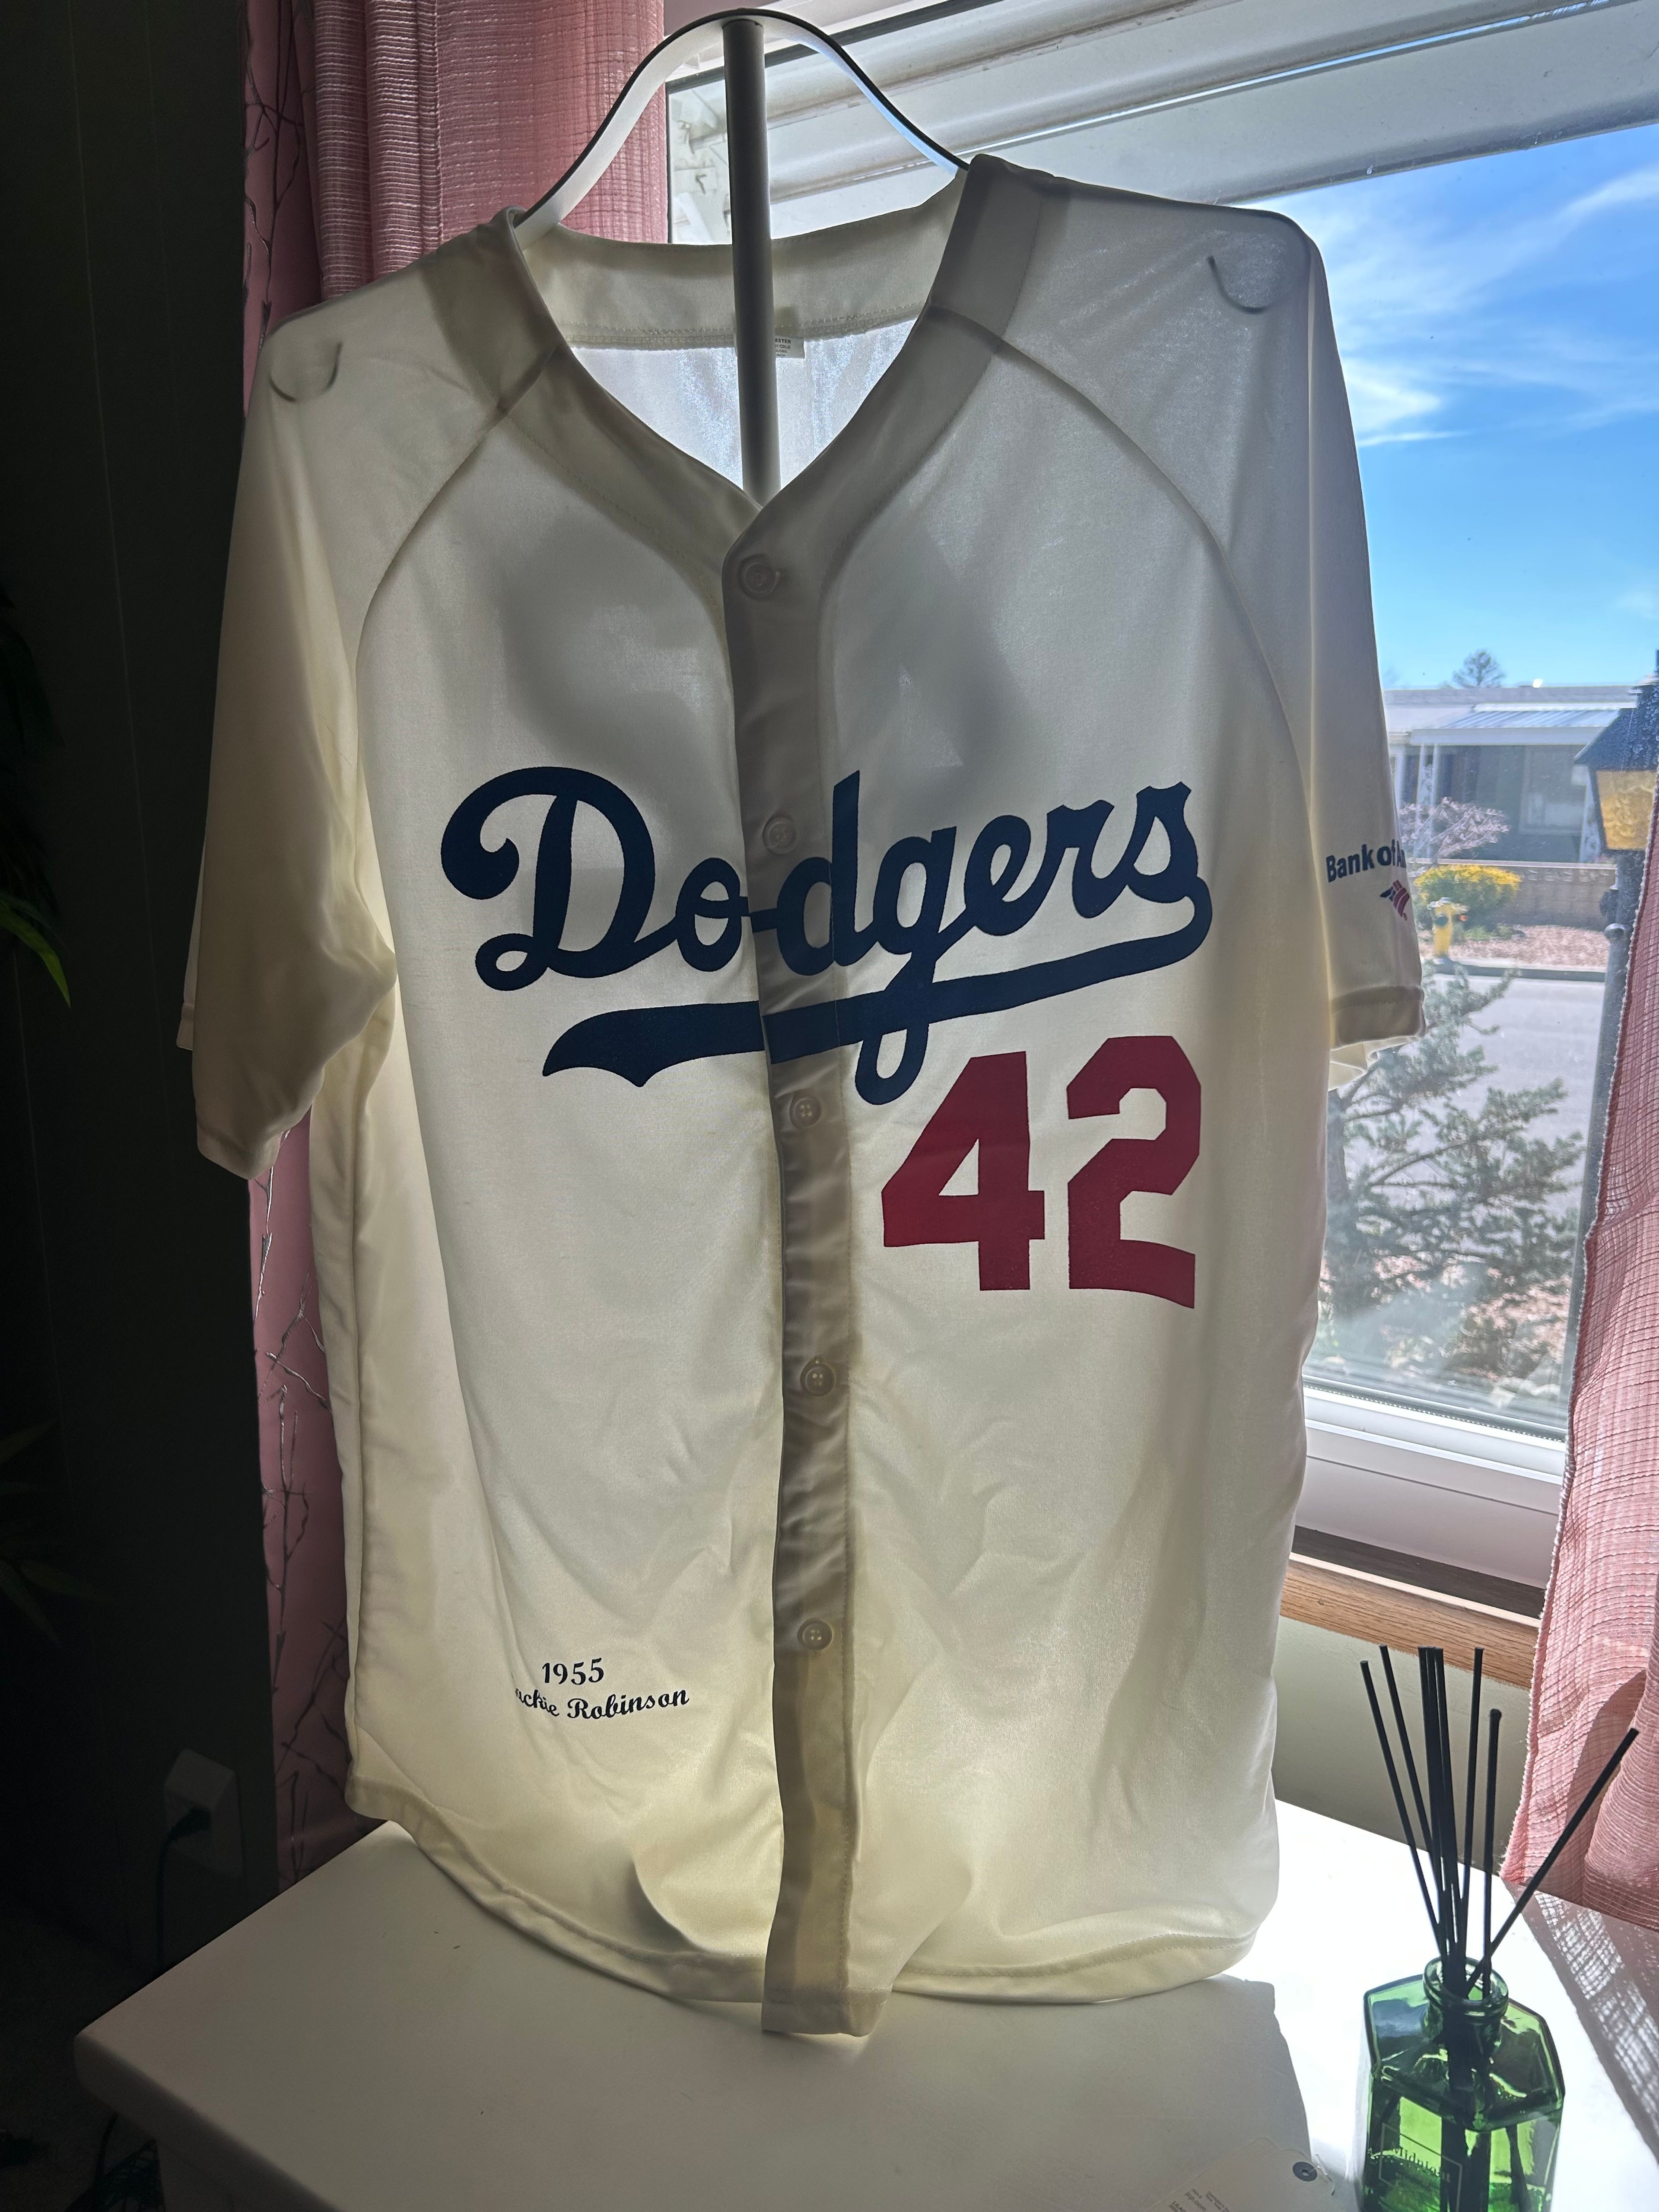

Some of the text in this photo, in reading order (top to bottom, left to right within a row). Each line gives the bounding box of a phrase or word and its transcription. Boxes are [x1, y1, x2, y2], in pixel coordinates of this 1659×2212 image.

[1326, 844, 1375, 883] Bank
[1377, 839, 1395, 866] of
[441, 766, 1213, 1105] Dodgers
[882, 1036, 1201, 1308] 42
[542, 1658, 604, 1685] 1955
[515, 1688, 689, 1719] ackie Robinson
